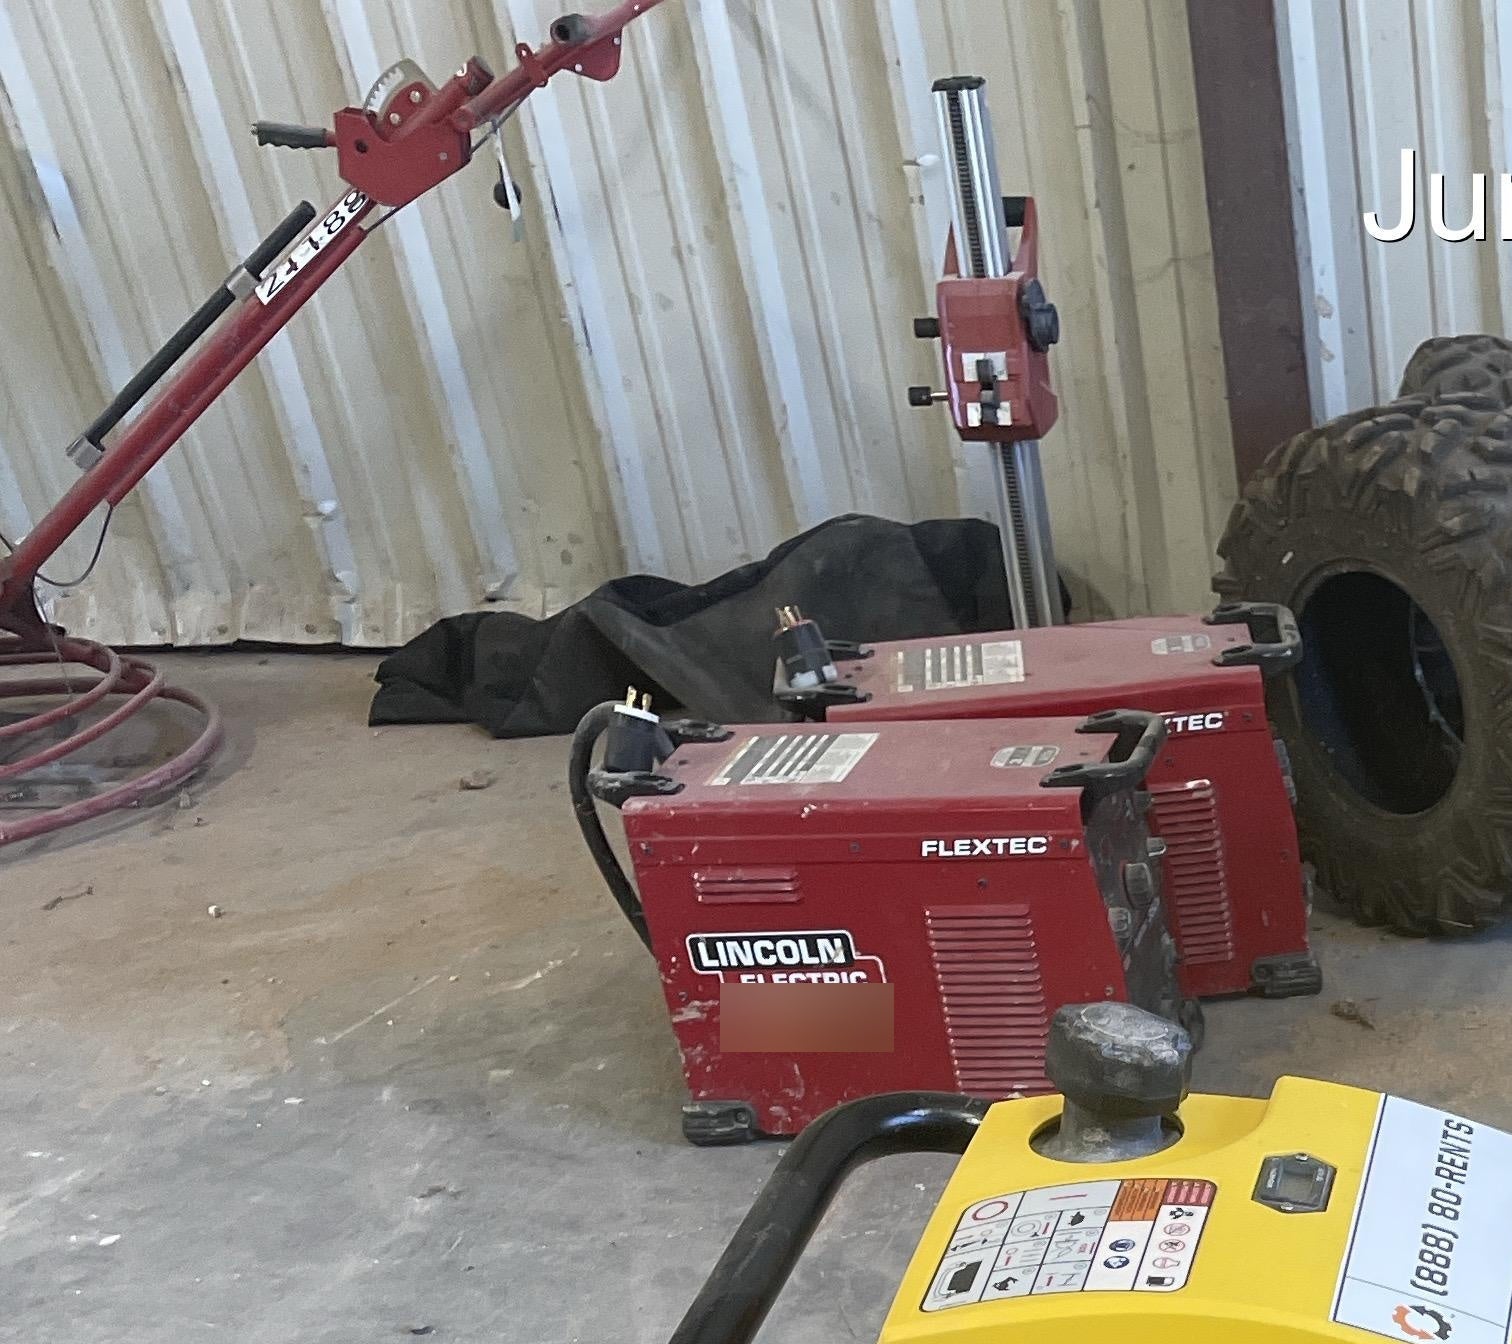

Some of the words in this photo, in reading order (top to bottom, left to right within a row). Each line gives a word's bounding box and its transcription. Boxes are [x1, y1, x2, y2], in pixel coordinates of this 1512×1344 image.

[921, 837, 1048, 857] FLEXTEC
[697, 937, 845, 968] LINCOLN
[1428, 1118, 1474, 1221] 80-RENTS
[1409, 1223, 1459, 1297] (888)
